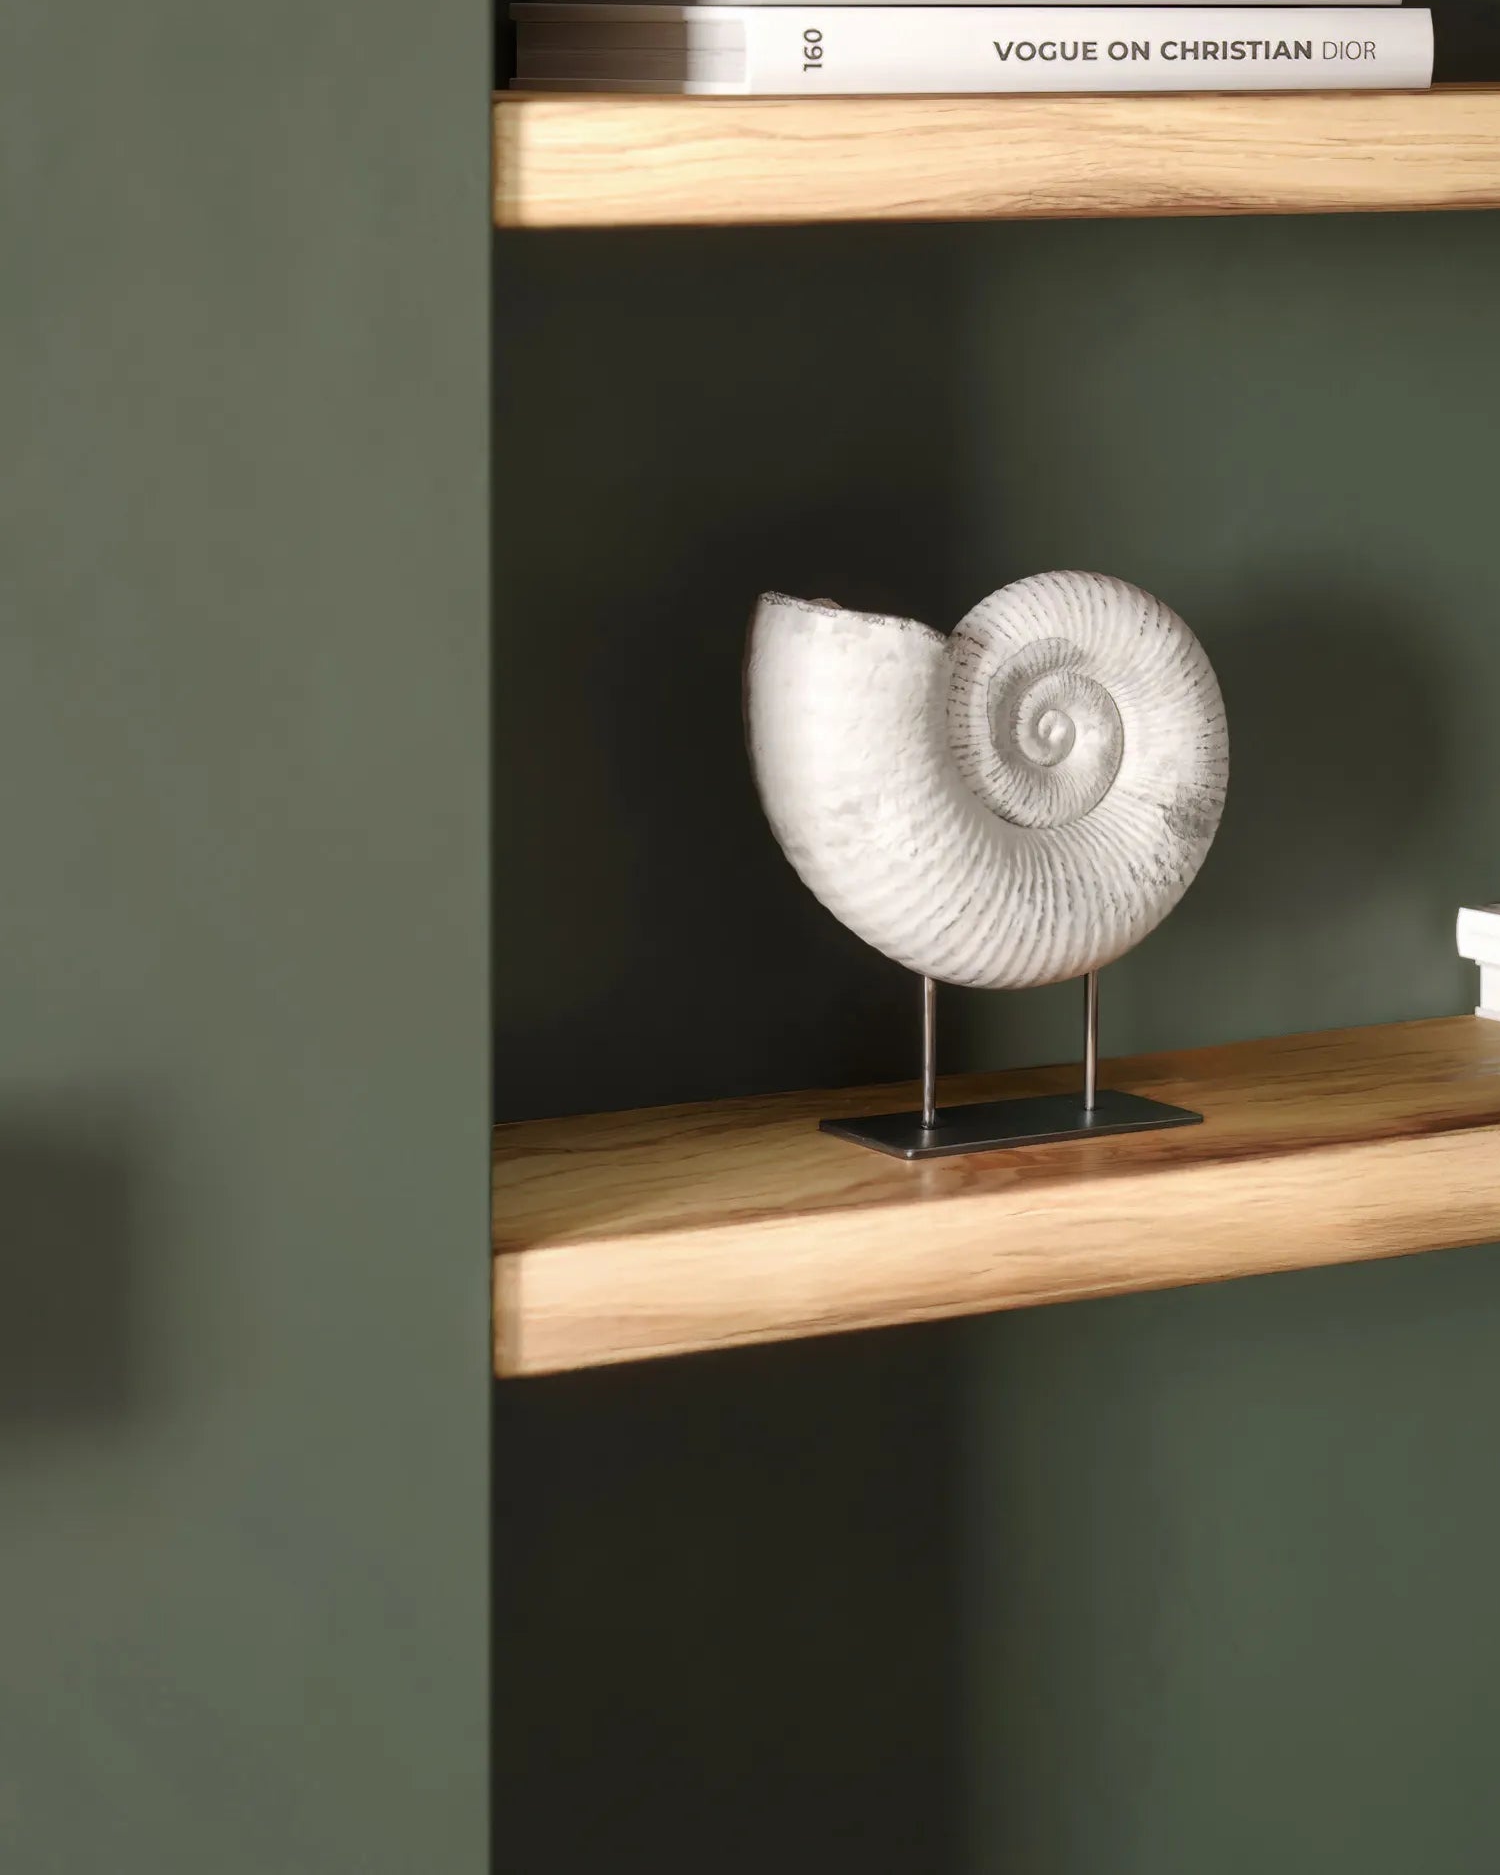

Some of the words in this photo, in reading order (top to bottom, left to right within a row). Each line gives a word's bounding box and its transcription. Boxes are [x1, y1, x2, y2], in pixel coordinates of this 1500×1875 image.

[803, 28, 823, 72] 160
[993, 41, 1098, 61] VOGUE
[1107, 41, 1150, 61] ON
[1160, 40, 1313, 61] CHRISTIAN
[1322, 40, 1376, 61] DIOR
